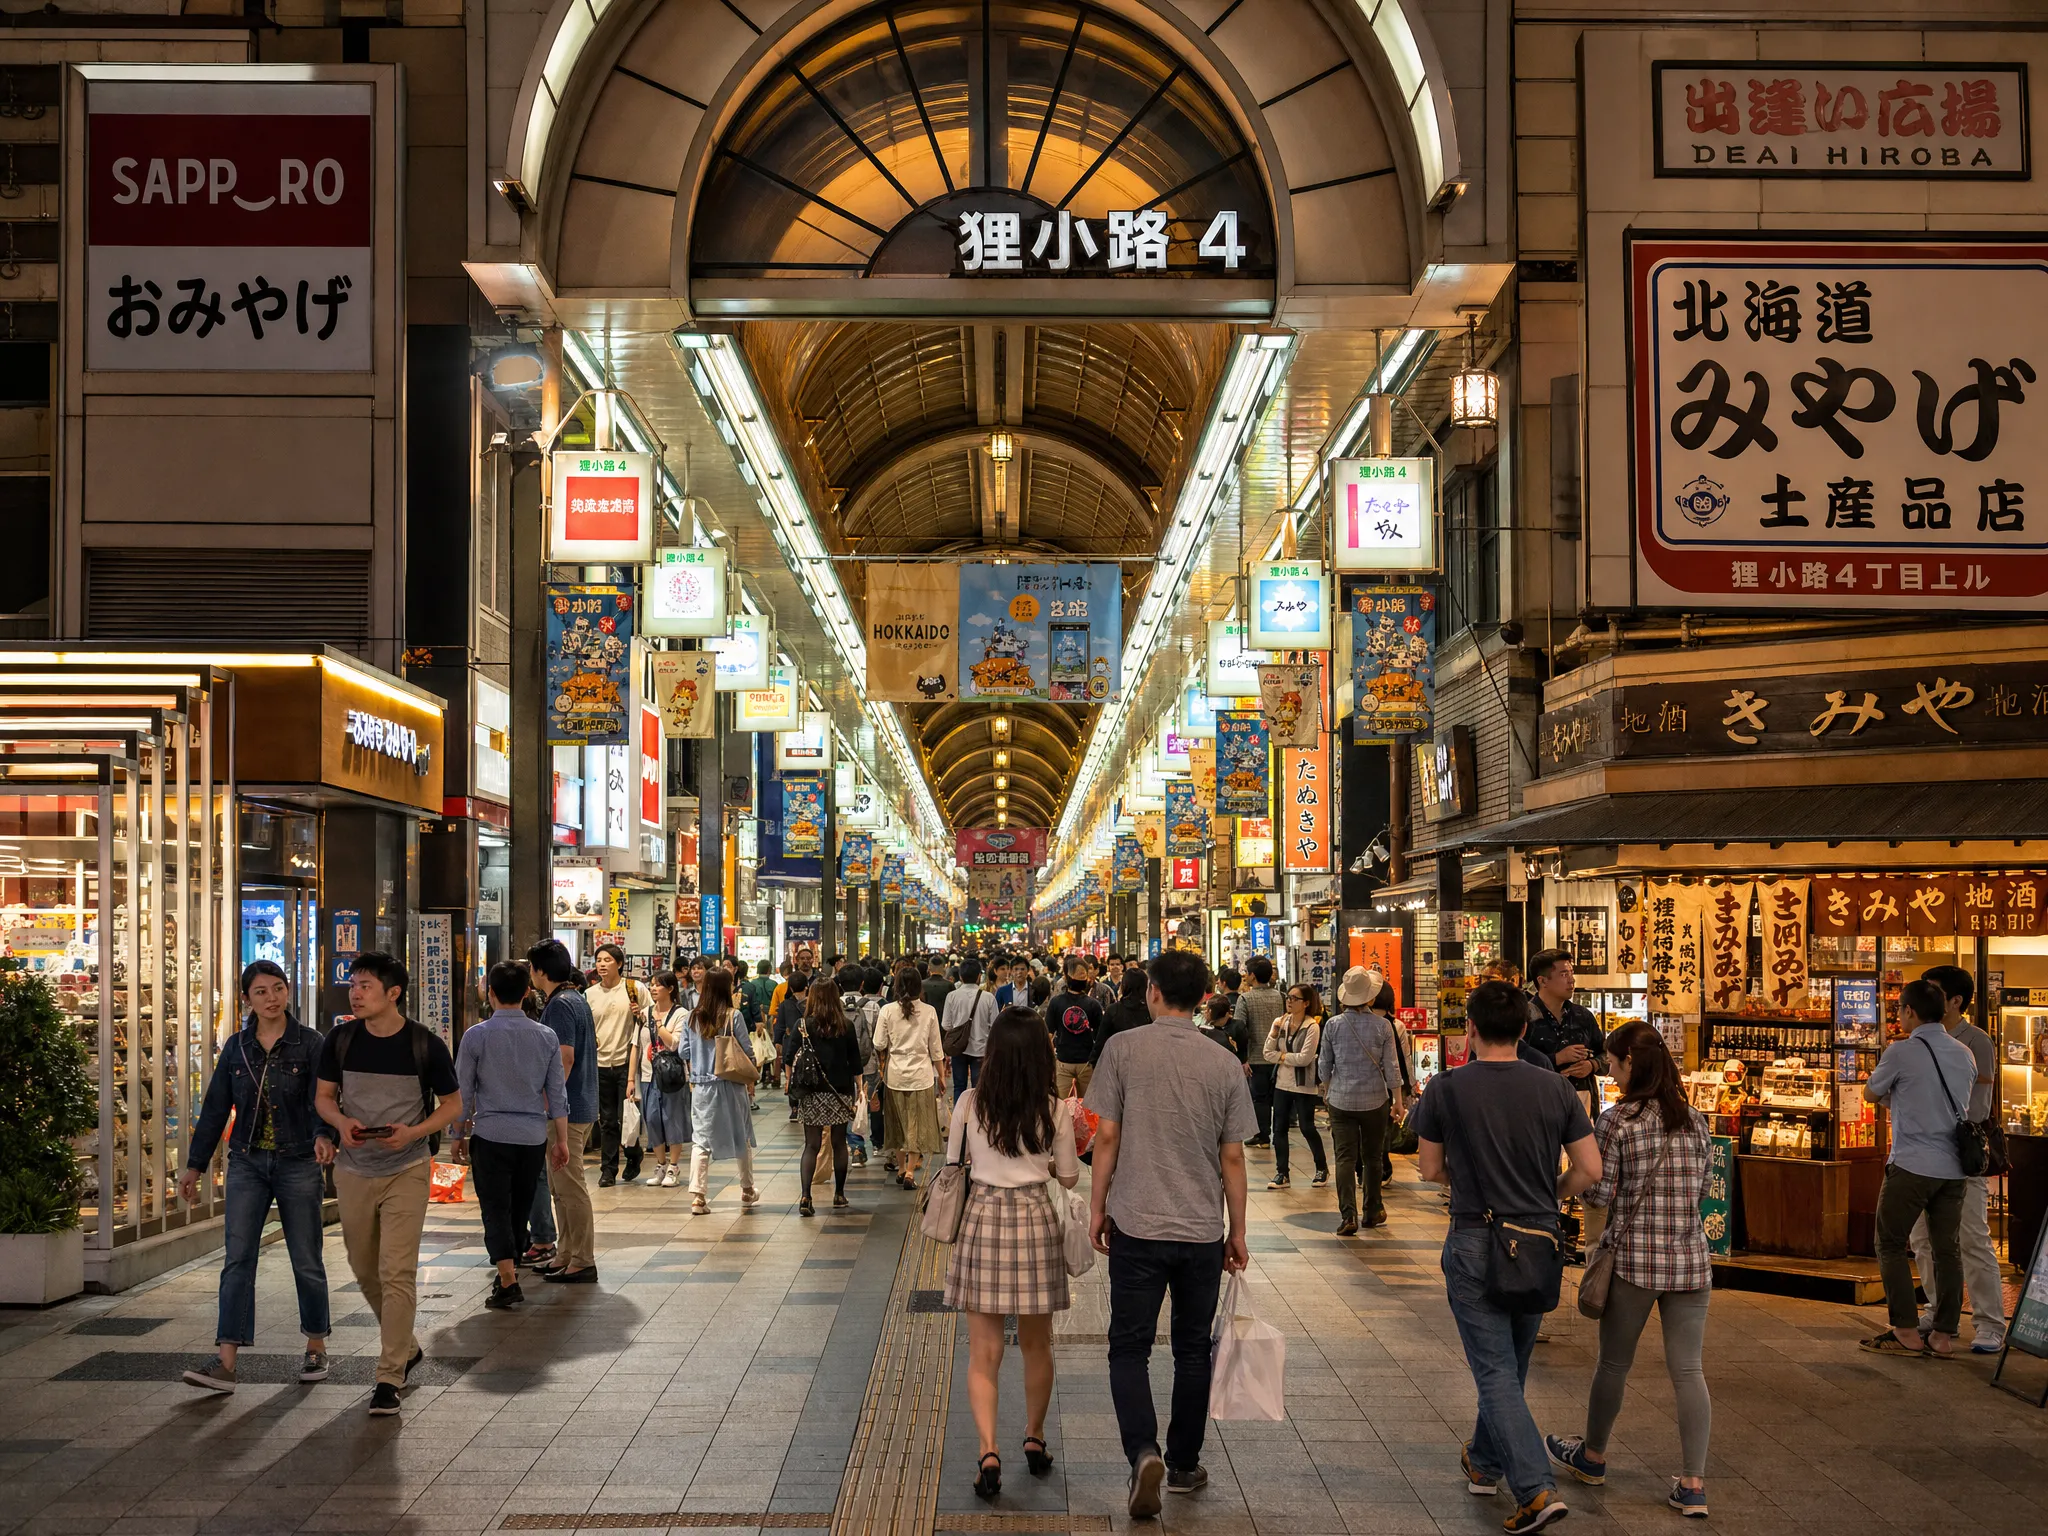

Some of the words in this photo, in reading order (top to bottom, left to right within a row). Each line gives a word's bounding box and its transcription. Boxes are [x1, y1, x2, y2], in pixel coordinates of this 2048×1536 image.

[1685, 79, 2002, 138] 出逢い広場
[1693, 144, 1799, 165] DEAI
[1827, 145, 1994, 167] HIROBA
[958, 209, 1169, 271] 狸小路
[1199, 209, 1247, 269] 4
[106, 274, 353, 341] おみやげ
[1672, 279, 1874, 344] 北海道
[1670, 356, 2037, 462] みやげ
[1759, 473, 2025, 532] 土産品店
[1731, 560, 1991, 591] 狸小路4丁目上ル
[873, 623, 950, 640] HOKKAIDO
[1620, 700, 1688, 733] 地酒
[1722, 676, 1975, 745] きみや
[1826, 886, 1947, 927] きみや
[1964, 880, 2037, 910] 地酒
